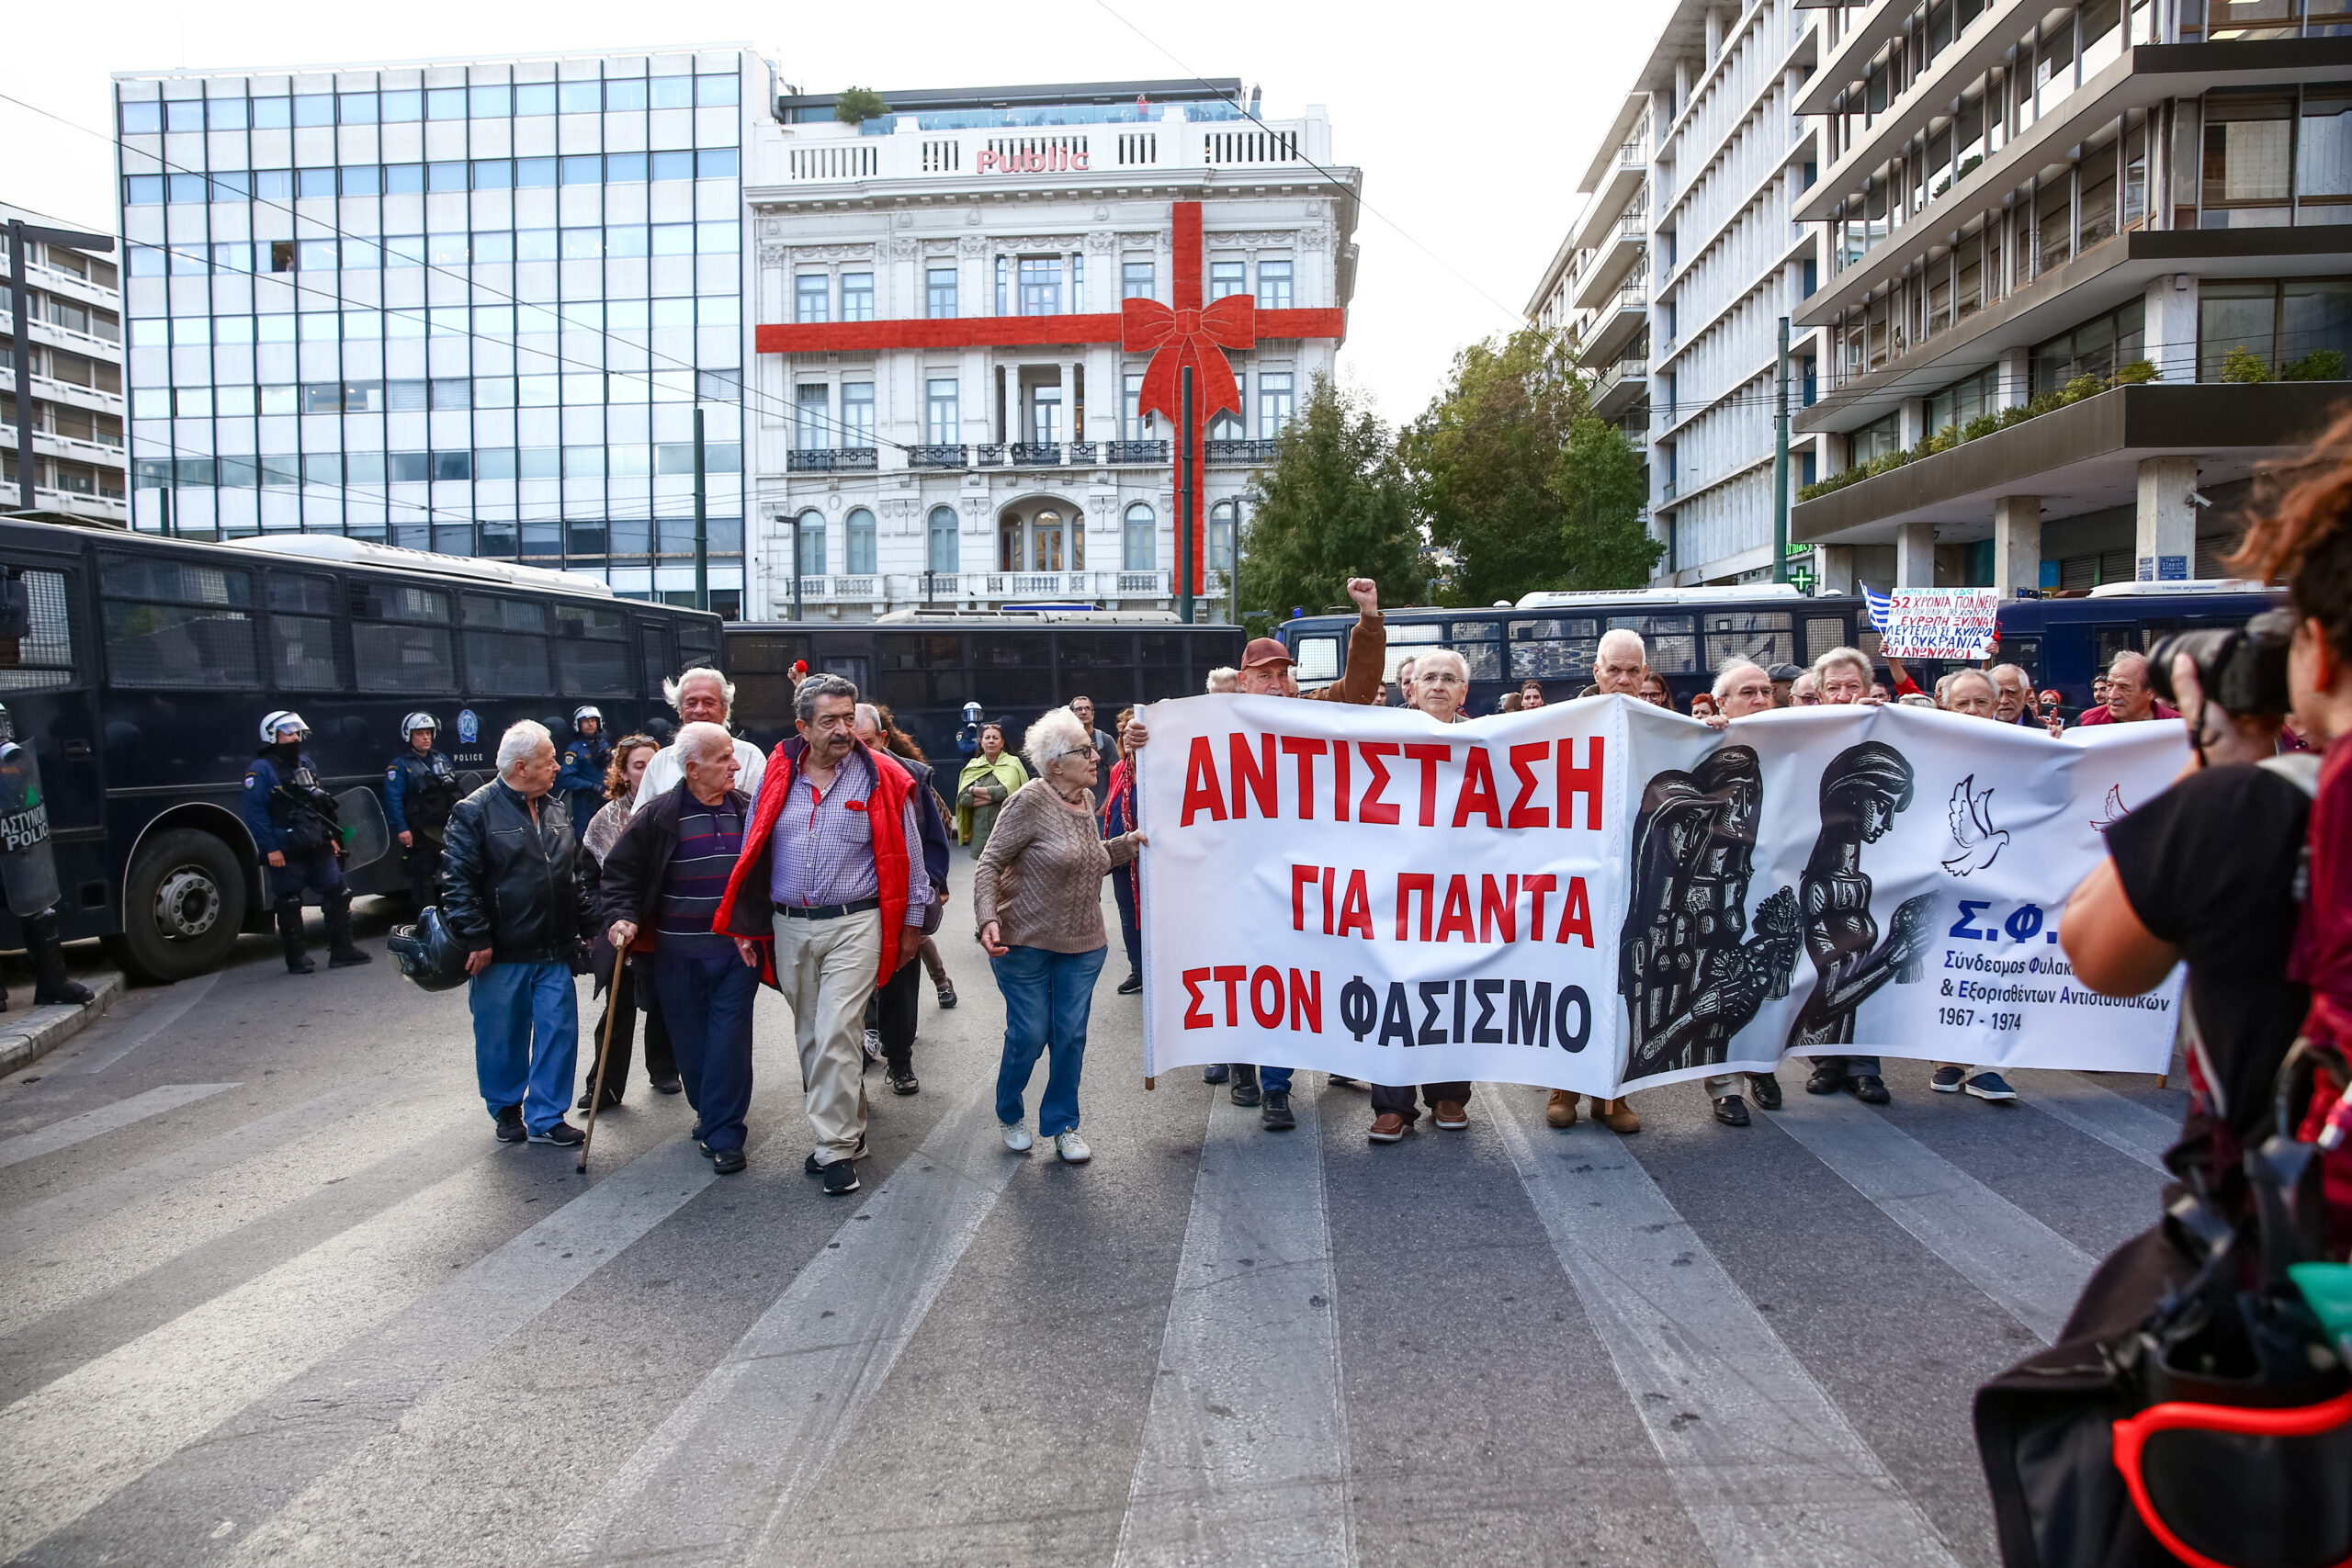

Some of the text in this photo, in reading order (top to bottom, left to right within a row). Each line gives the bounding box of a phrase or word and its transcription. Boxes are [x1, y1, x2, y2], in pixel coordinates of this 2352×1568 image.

[977, 146, 1089, 174] Public
[1891, 596, 1911, 608] 52
[1913, 596, 1951, 608] ΧΡΟΝΙΑ
[1901, 616, 1995, 627] ΕΥΡΩΠΗ ΞΥΠΝΑ!
[1940, 626, 1951, 637] ΣΕ
[1954, 626, 1993, 637] ΚΥΠΡΟ
[1885, 647, 1899, 656] ΟΙ
[1886, 636, 1982, 649] ΚΑΙ ΟΥΚΡΑΝΙΑ
[454, 753, 483, 761] POLICE
[1181, 732, 1604, 830] ΑΝΤΙΣΤΑΣΗ
[6, 822, 51, 851] POLIC
[1292, 864, 1594, 948] ΓΙΑ ΠΑΝΤΑ
[1944, 950, 2075, 976] Σύνδεσμος Φυλακ
[1940, 978, 1953, 997] &
[1958, 980, 2056, 1004] Εξορισθέντων
[1182, 965, 1591, 1054] ΣΤΟΝ ΦΑΣΙΣΜΟ
[1939, 1007, 1974, 1026] 1967
[1992, 1012, 2021, 1031] 1974
